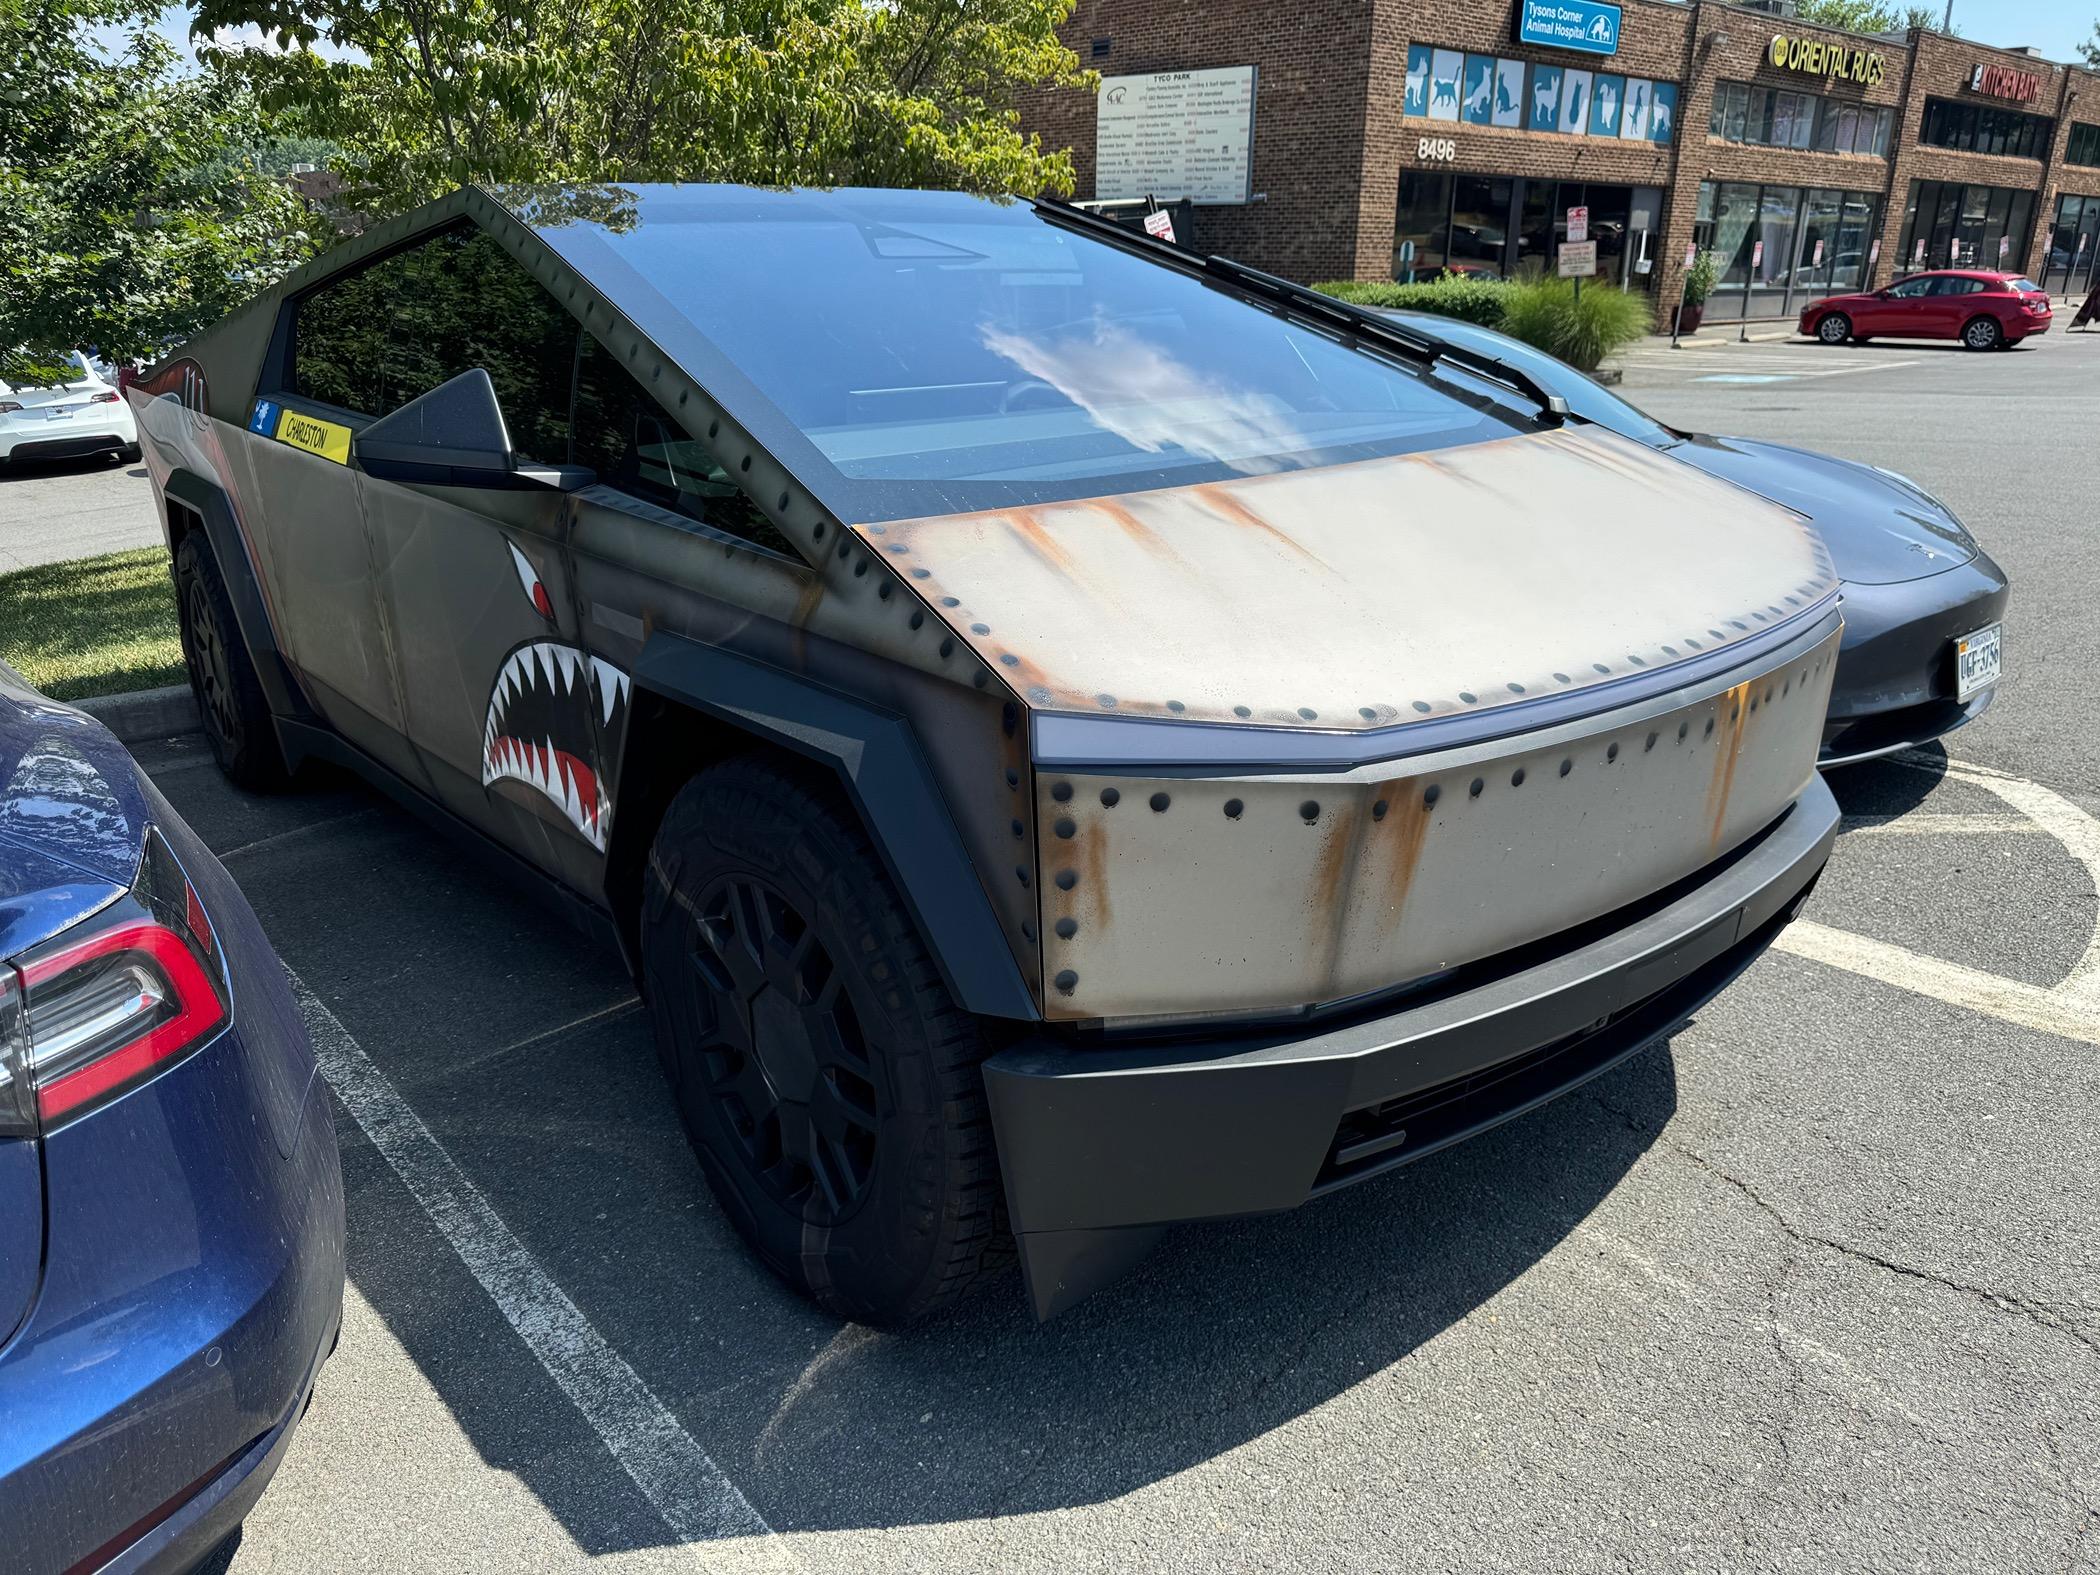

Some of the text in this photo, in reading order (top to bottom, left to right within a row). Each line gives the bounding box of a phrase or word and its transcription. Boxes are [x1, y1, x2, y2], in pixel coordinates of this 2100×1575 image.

[1529, 2, 1583, 22] Tysons Corner
[1526, 18, 1585, 40] Animal Hospital
[1789, 36, 1886, 85] ORIENTAL RUGS
[1979, 64, 2019, 99] KITCHEN
[2017, 73, 2041, 103] BATH
[1418, 138, 1456, 161] 8496
[286, 417, 328, 449] CHARLESTON
